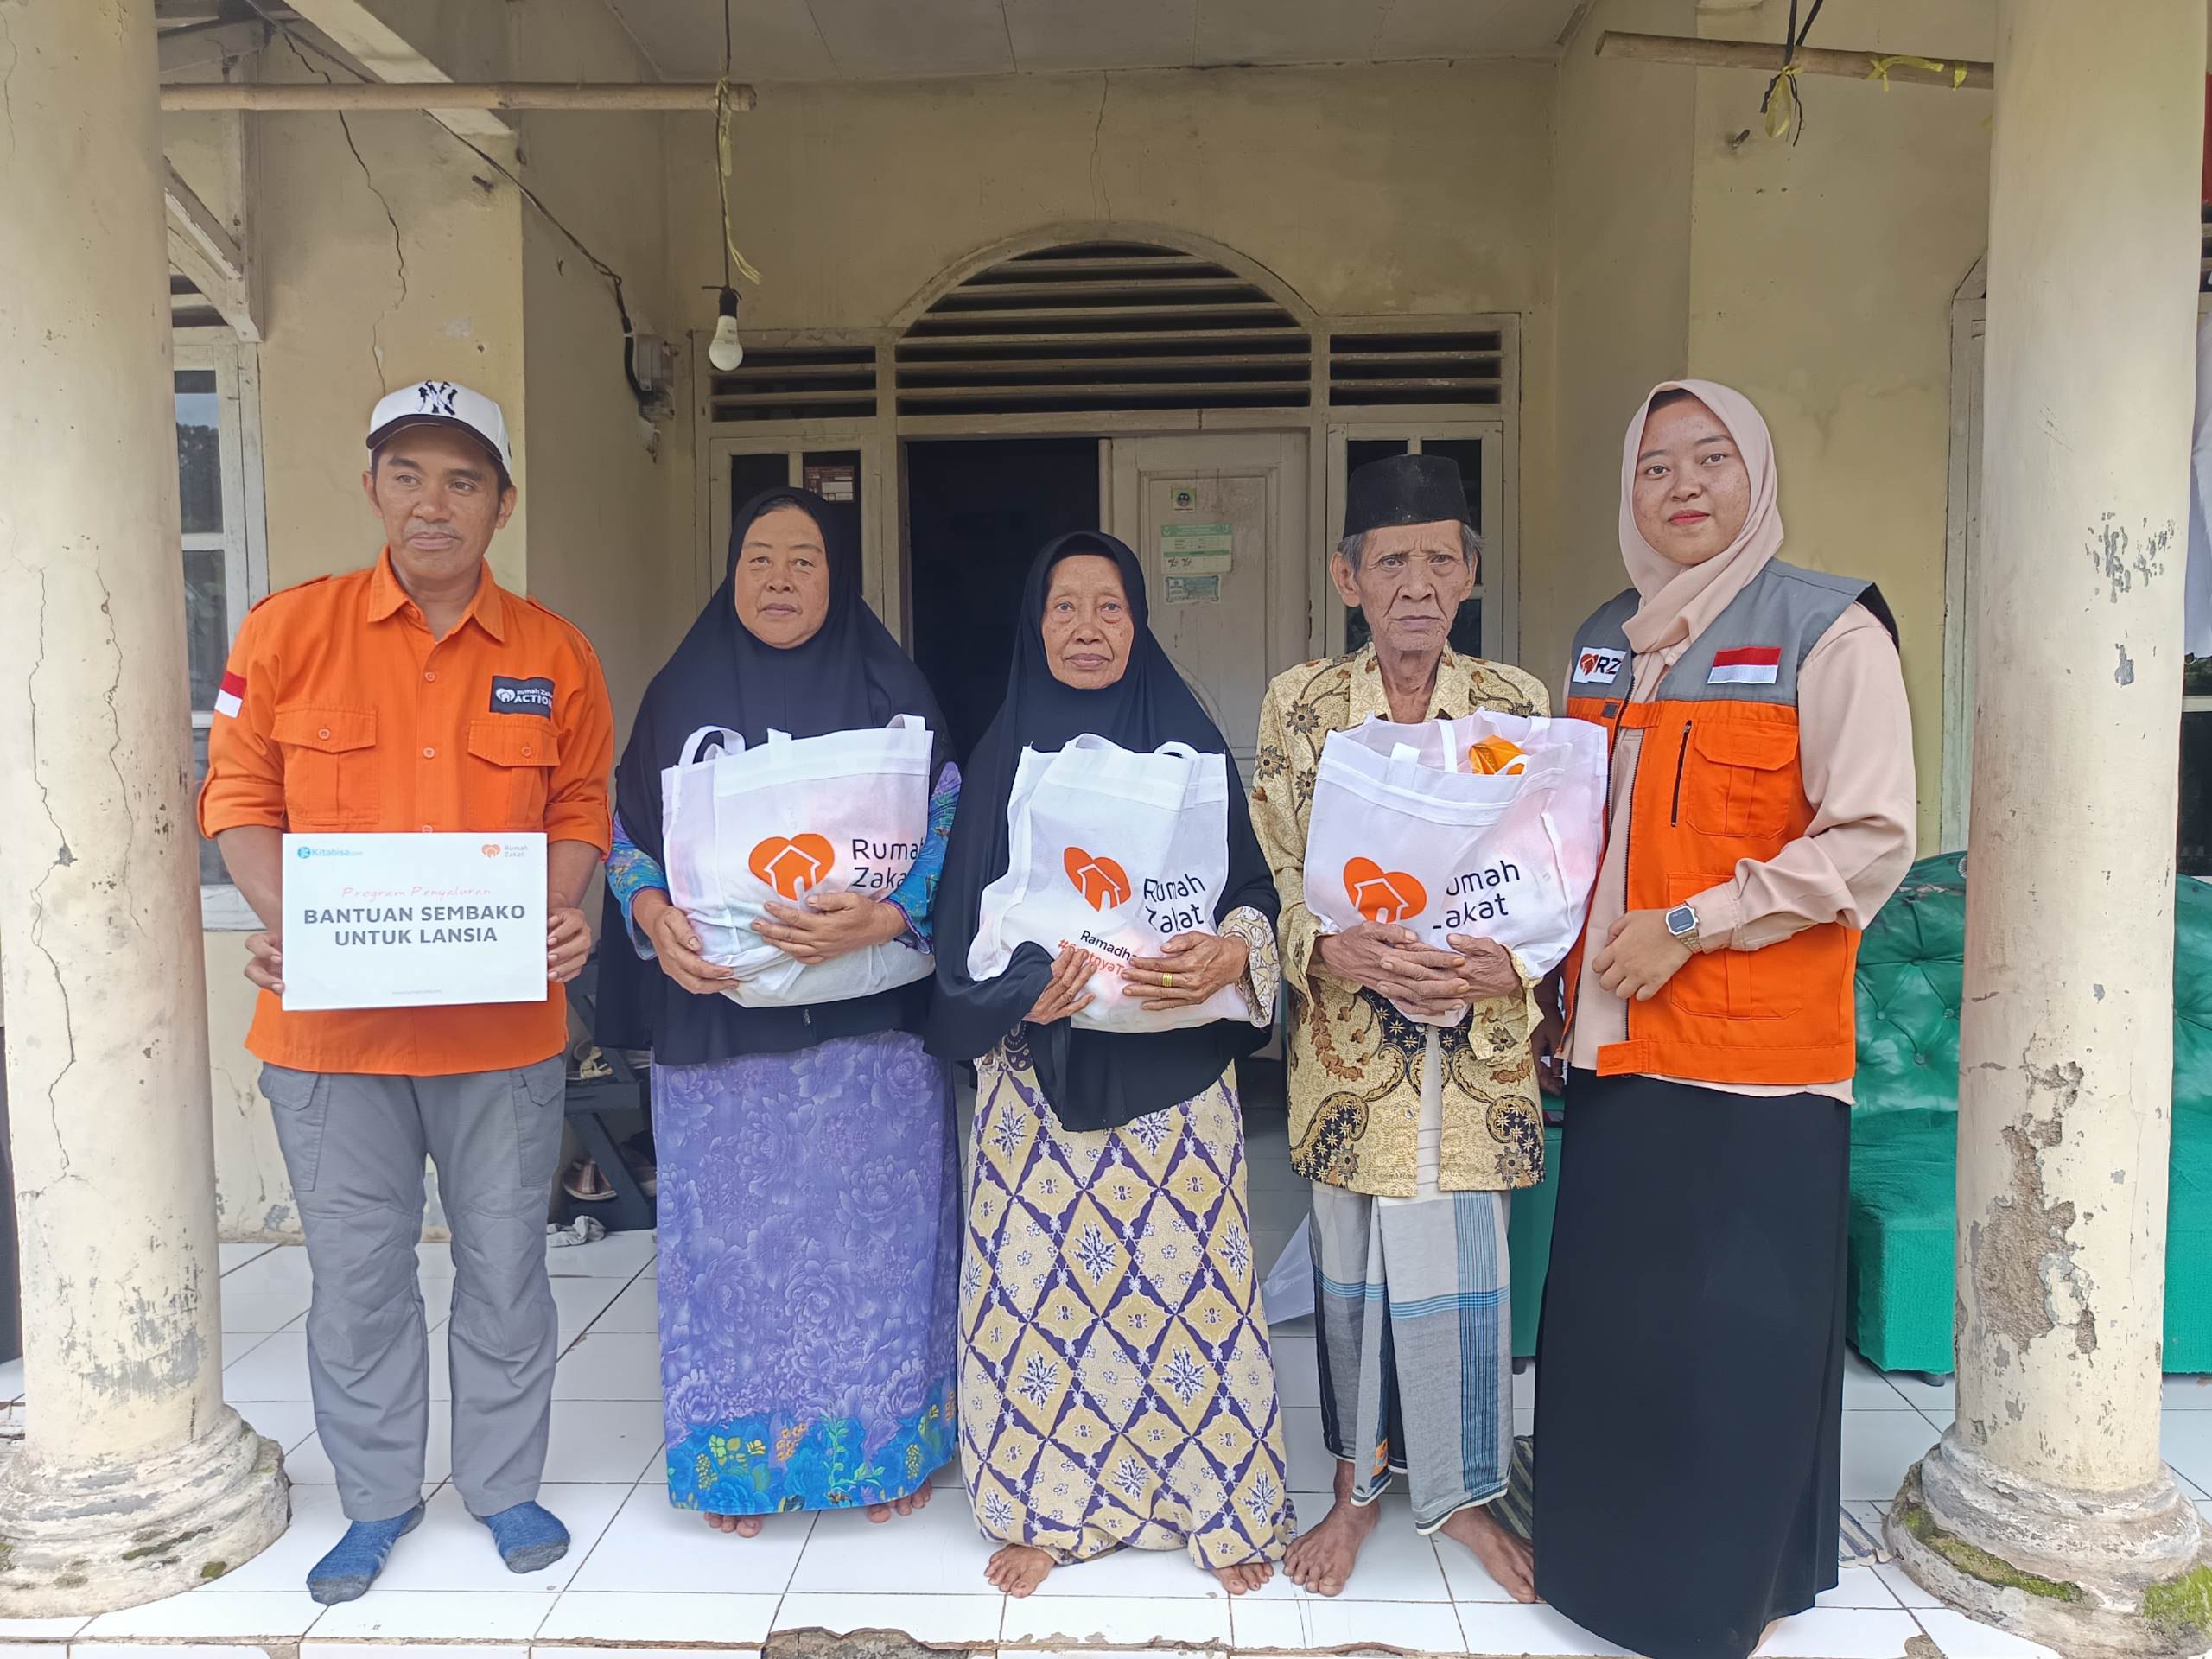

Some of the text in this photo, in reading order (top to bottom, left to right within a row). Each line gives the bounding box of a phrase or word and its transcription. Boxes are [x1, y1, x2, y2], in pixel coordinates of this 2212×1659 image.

[1594, 656, 1623, 675] RZ
[852, 867, 907, 889] Zaka
[1143, 873, 1206, 903] Rumah
[1446, 860, 1521, 896] umah
[341, 886, 492, 903] Program Penyaluran
[304, 905, 525, 924] BANTUAN SEMBAKO
[1433, 893, 1509, 930] akat
[335, 927, 498, 945] UNTUK LANSIA
[1080, 930, 1138, 961] Ramadh
